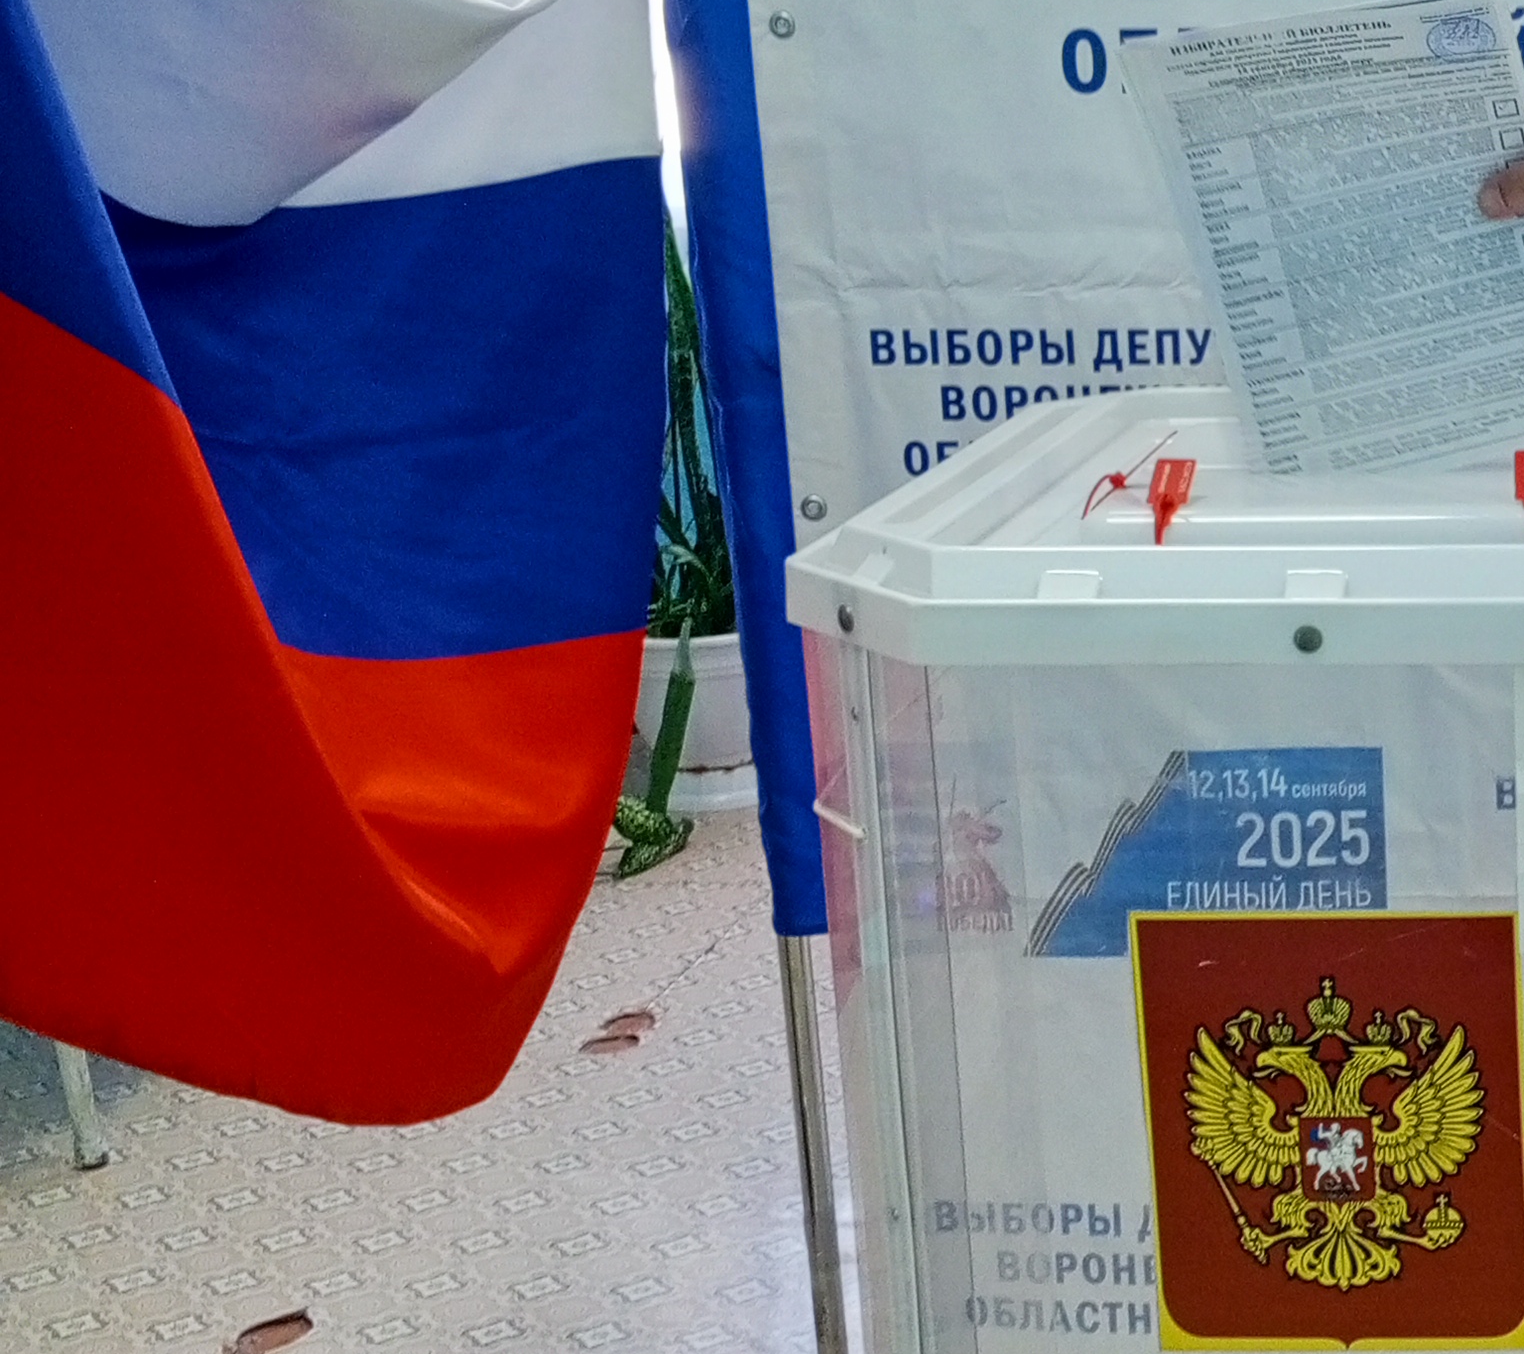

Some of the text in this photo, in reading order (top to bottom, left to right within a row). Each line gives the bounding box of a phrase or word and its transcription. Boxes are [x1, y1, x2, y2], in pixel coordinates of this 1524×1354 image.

[869, 328, 1075, 366] ВЫБОРЫ
[1189, 768, 1367, 802] 12,13,14 сентября
[1236, 810, 1370, 868] 2025
[1167, 875, 1372, 911] ЕДИНЫЙ ДЕНЬ
[934, 1200, 1121, 1237] ВЫБОРЫ
[965, 1296, 1152, 1335] ОБЛАСТН
